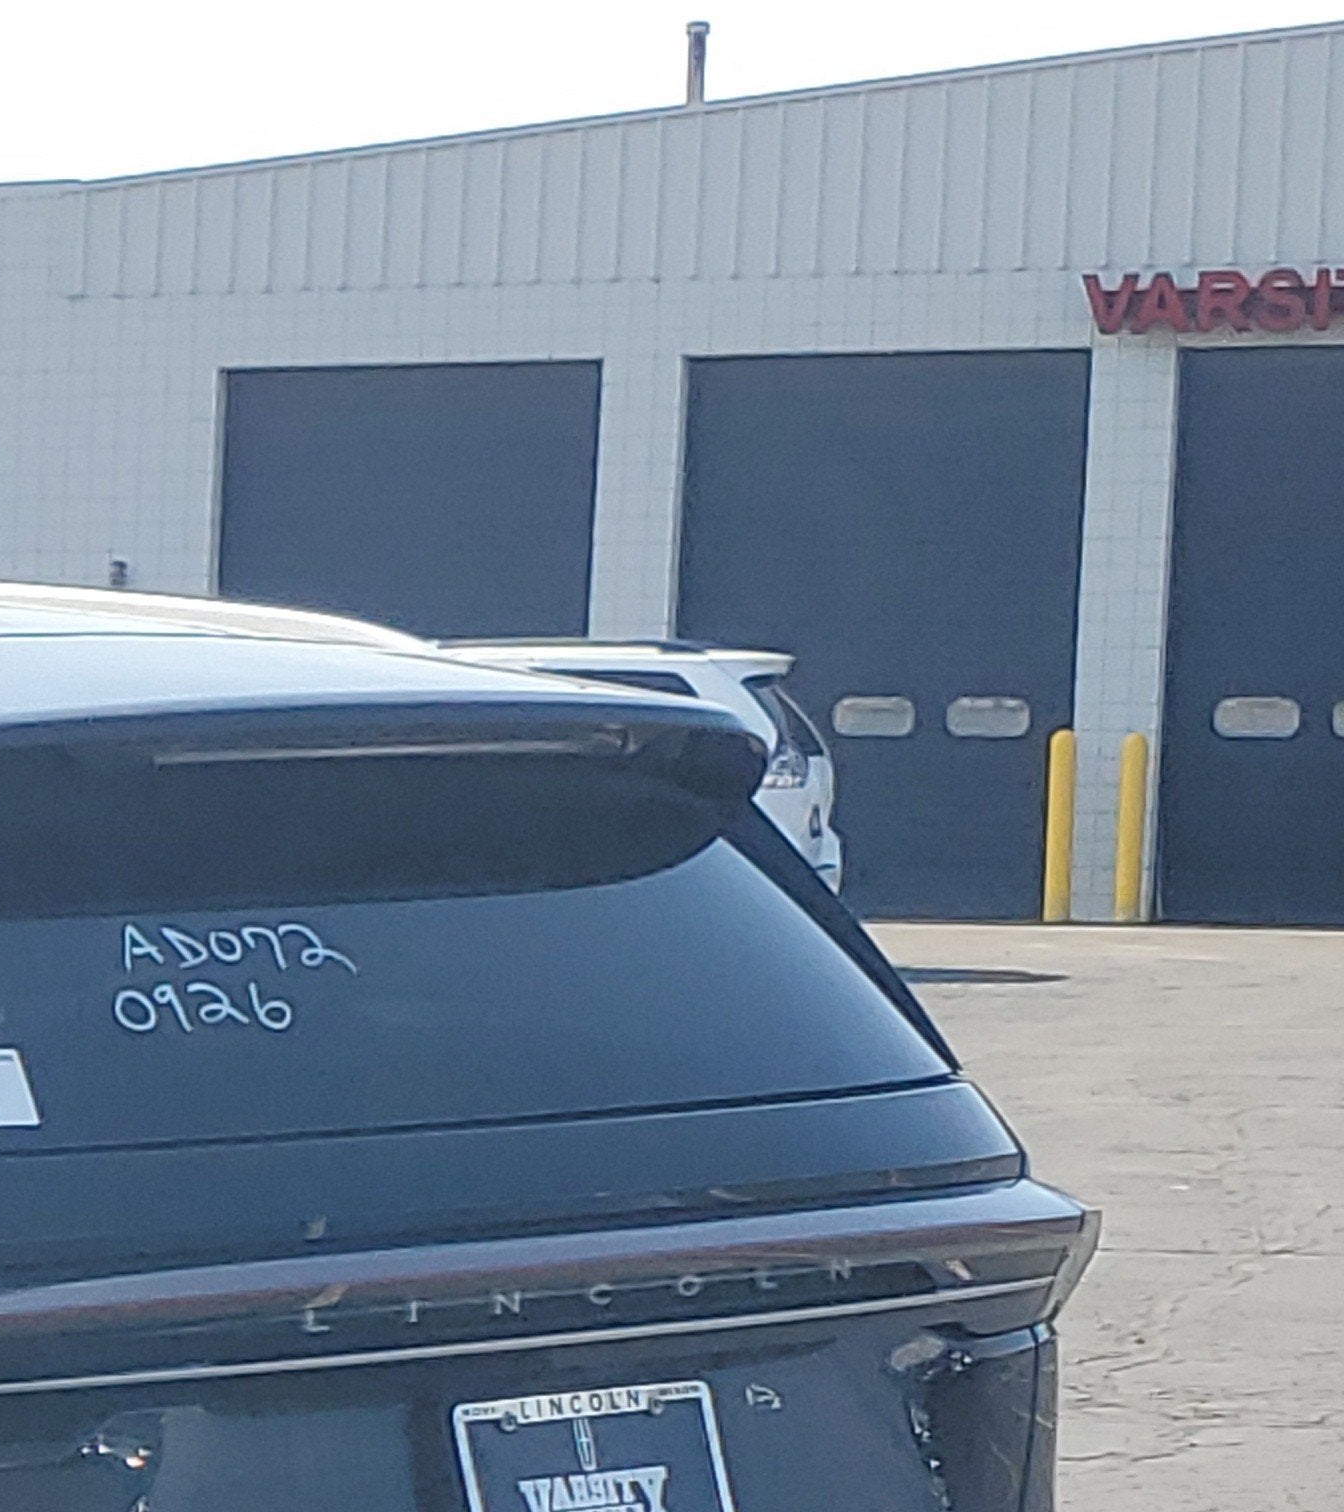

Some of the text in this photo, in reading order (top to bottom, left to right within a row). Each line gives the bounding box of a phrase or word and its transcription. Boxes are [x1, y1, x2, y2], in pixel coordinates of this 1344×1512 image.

[1081, 267, 1344, 335] VARSI
[113, 982, 293, 1034] 0926
[304, 1256, 854, 1333] LINCOLN
[519, 1389, 641, 1421] LINCOLN
